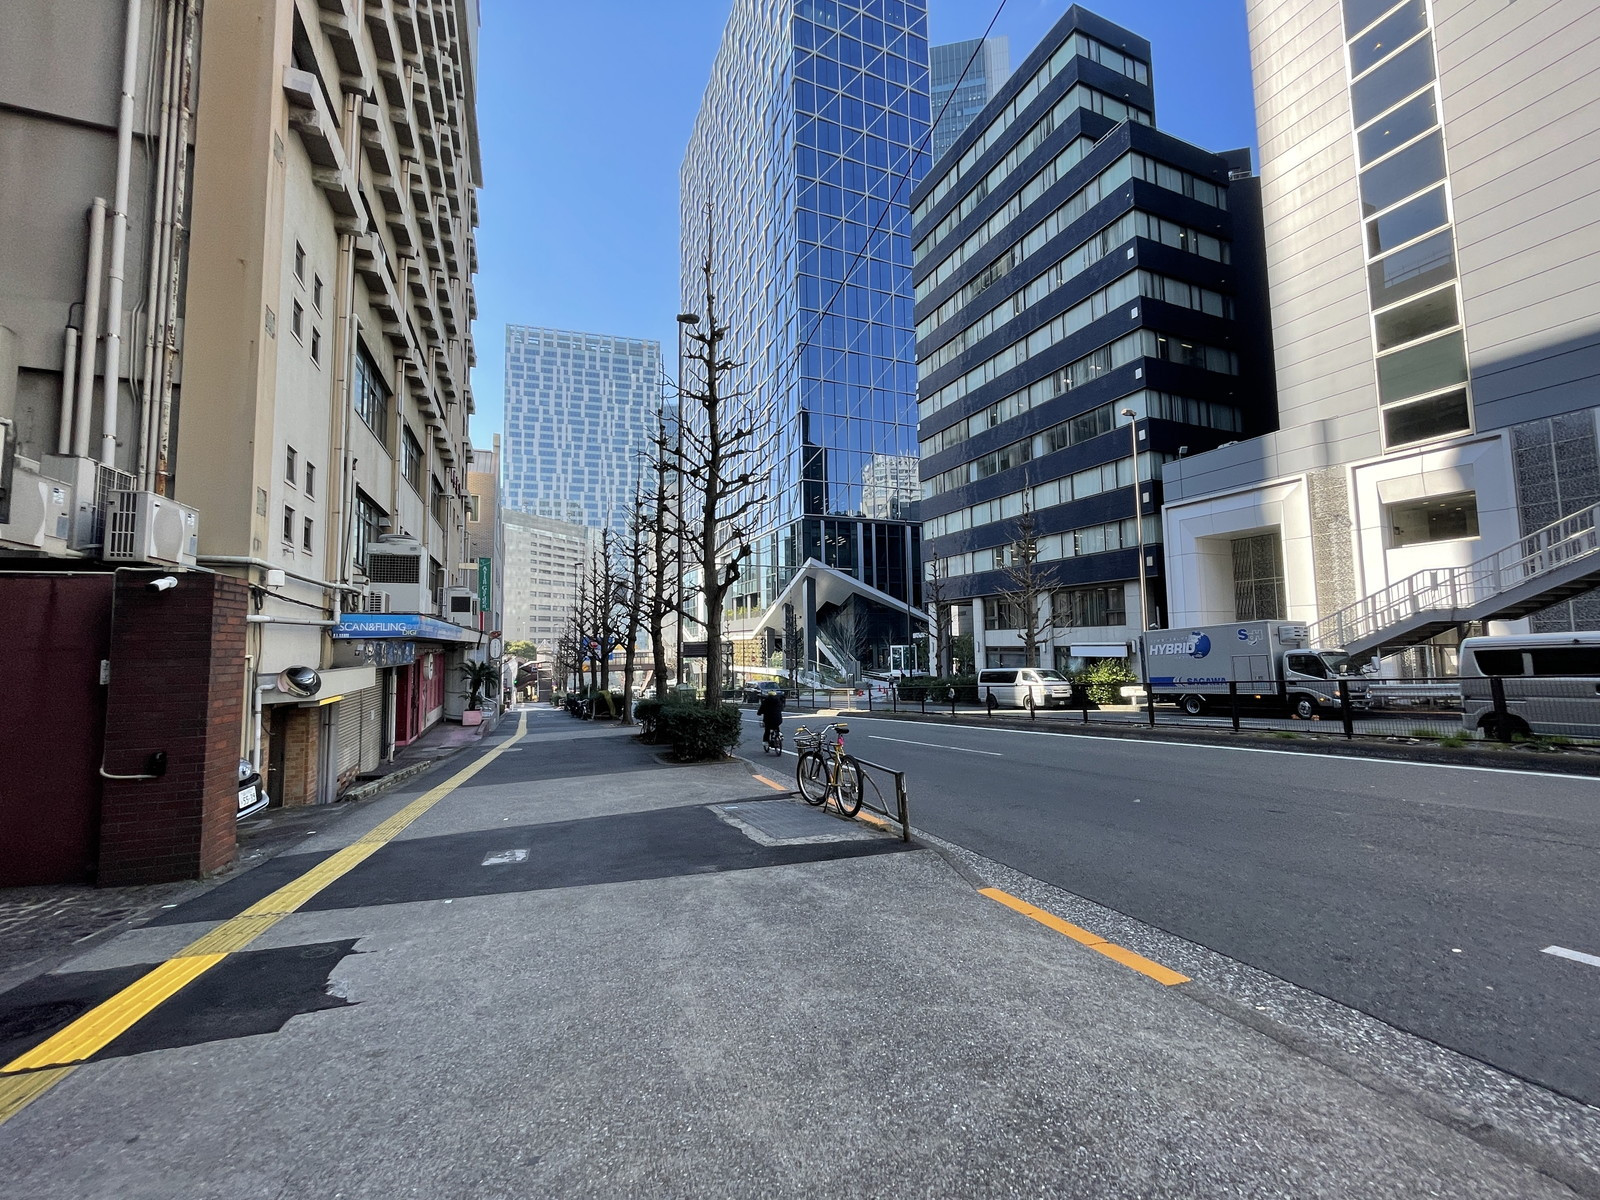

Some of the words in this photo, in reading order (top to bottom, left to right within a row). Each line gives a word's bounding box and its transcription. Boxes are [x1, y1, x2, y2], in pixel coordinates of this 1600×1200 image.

[339, 622, 406, 632] SCAN&FILING
[1150, 642, 1196, 655] HYBRID
[1186, 677, 1227, 686] SAGAWA
